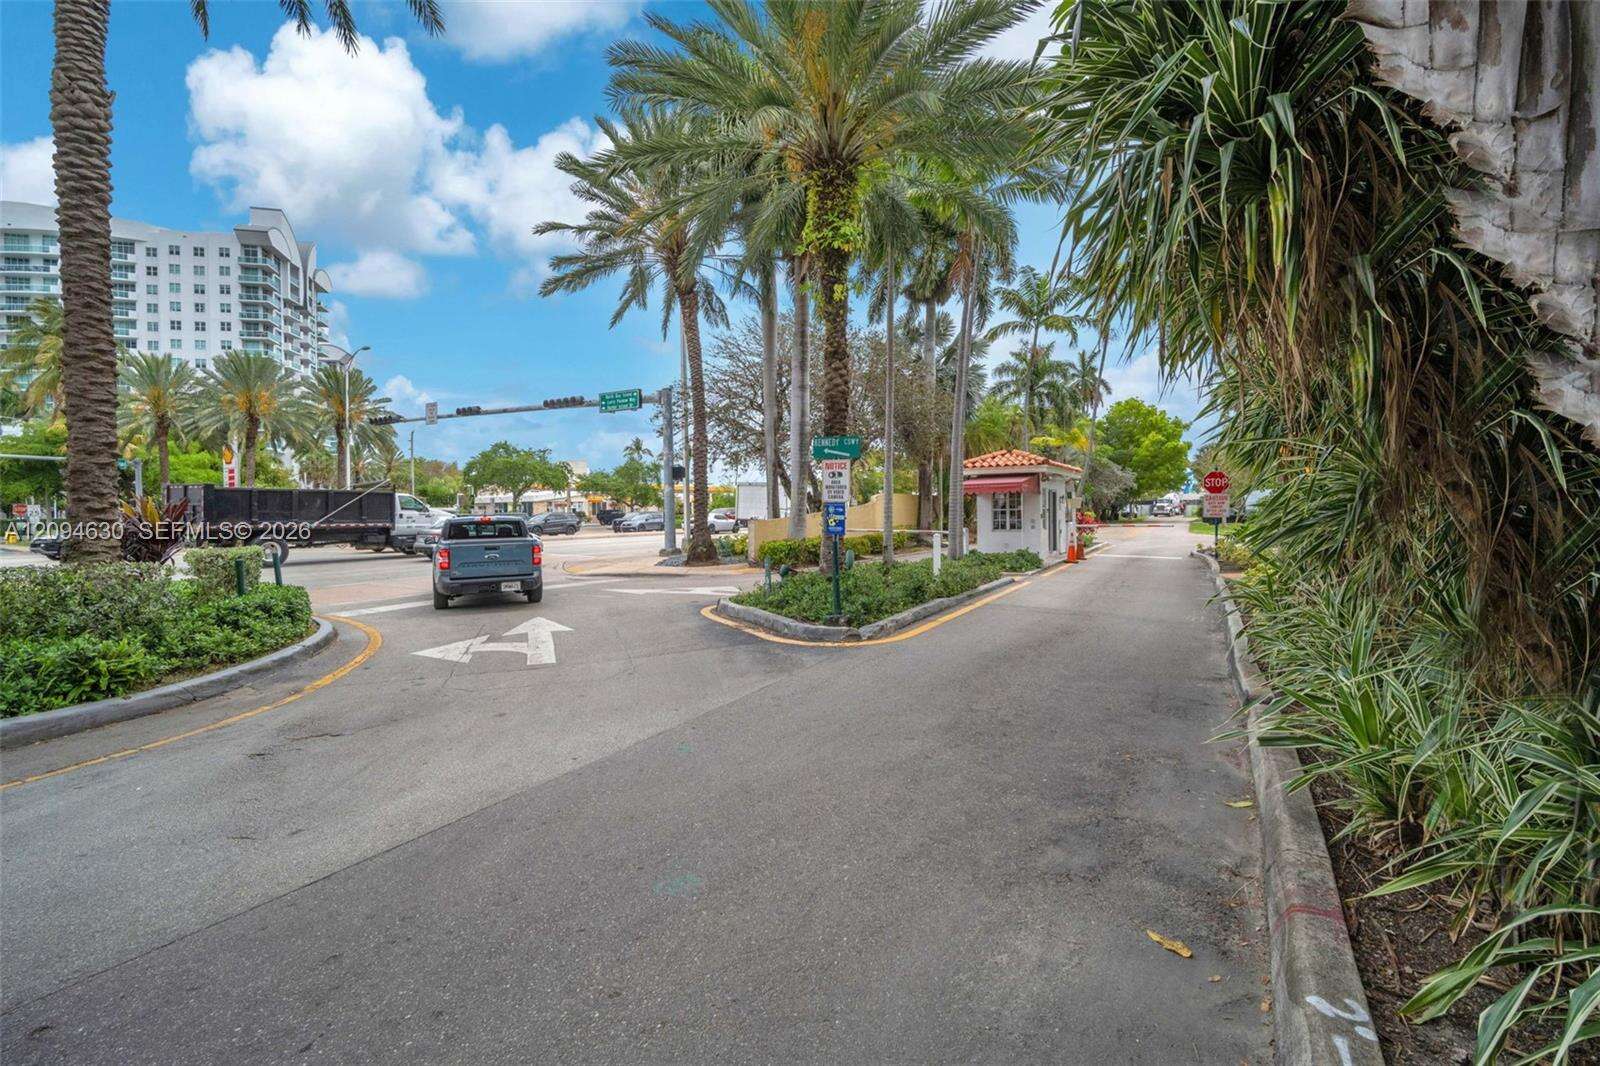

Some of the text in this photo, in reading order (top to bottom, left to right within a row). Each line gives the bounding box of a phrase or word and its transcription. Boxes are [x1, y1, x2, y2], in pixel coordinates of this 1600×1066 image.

[814, 438, 839, 447] KENNEDY
[825, 462, 848, 470] NOTICE
[1205, 477, 1229, 488] STOP
